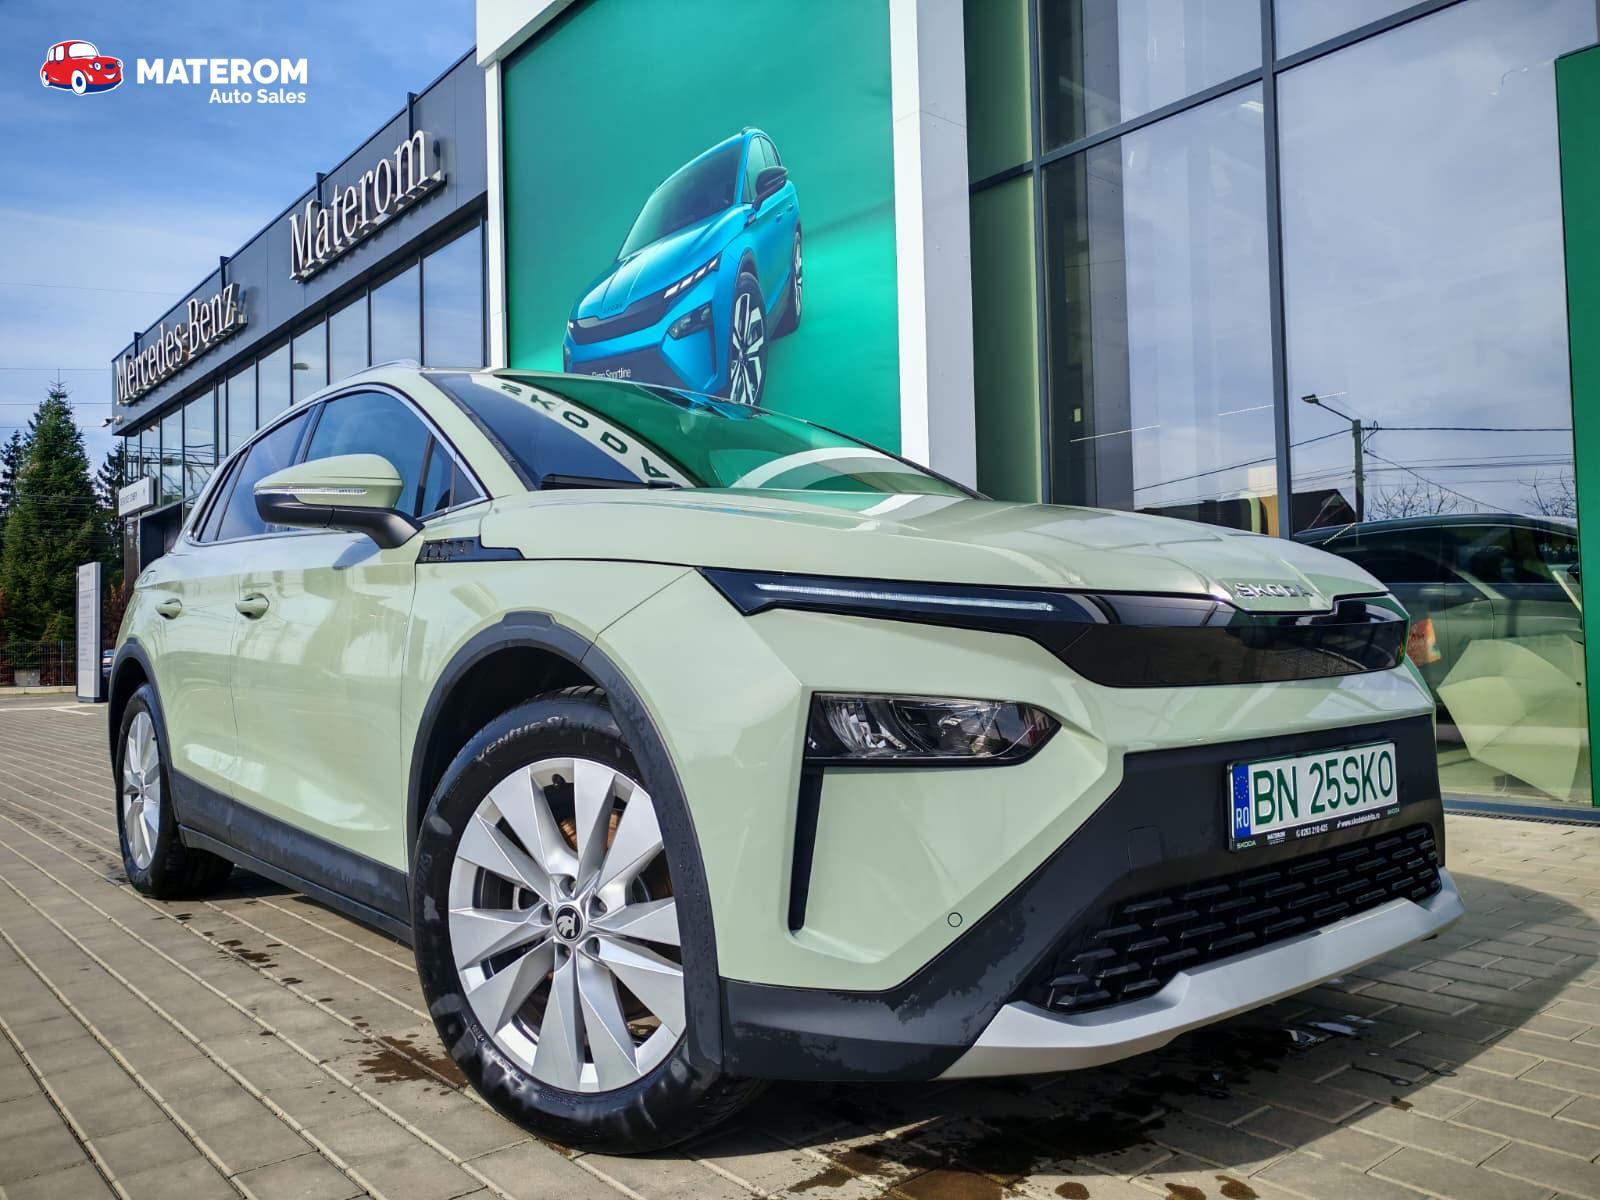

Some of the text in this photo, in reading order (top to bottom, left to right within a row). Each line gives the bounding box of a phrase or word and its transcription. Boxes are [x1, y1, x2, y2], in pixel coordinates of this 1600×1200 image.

[289, 129, 430, 280] Materom
[116, 283, 236, 406] Mercedes-Benz
[1235, 806, 1250, 829] RO
[1252, 750, 1394, 826] BN 25SKO
